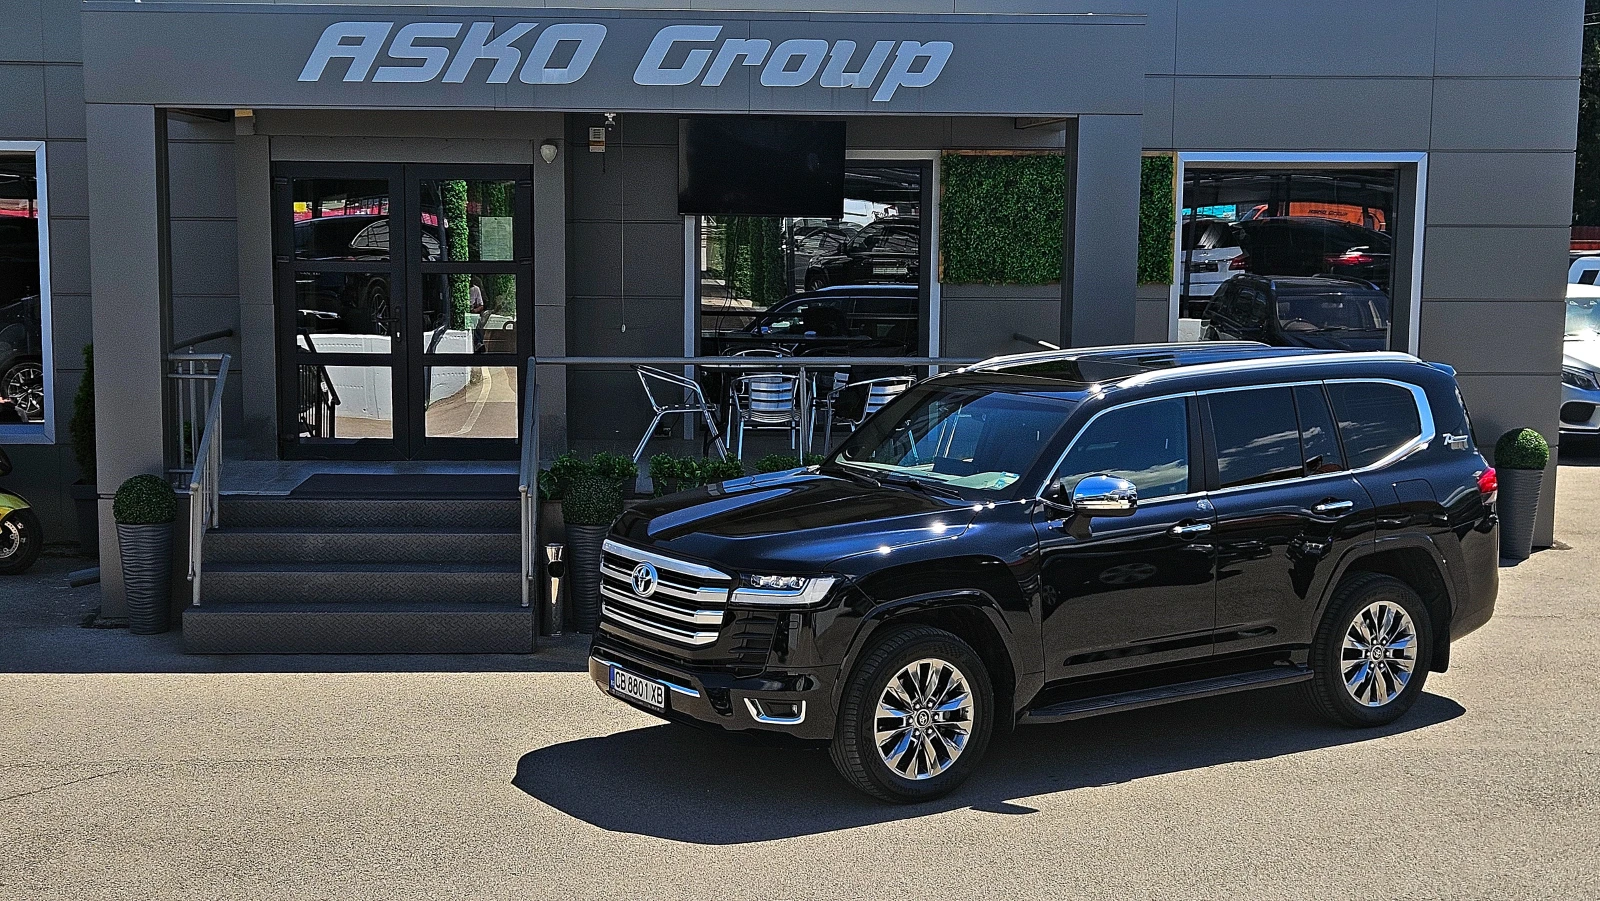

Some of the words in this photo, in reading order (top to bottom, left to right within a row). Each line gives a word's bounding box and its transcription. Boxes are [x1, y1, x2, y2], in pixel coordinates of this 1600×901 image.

[297, 21, 608, 85] ASKO
[632, 24, 955, 102] Group
[615, 671, 626, 691] CB
[627, 675, 649, 701] 8801
[650, 684, 663, 705] XB
